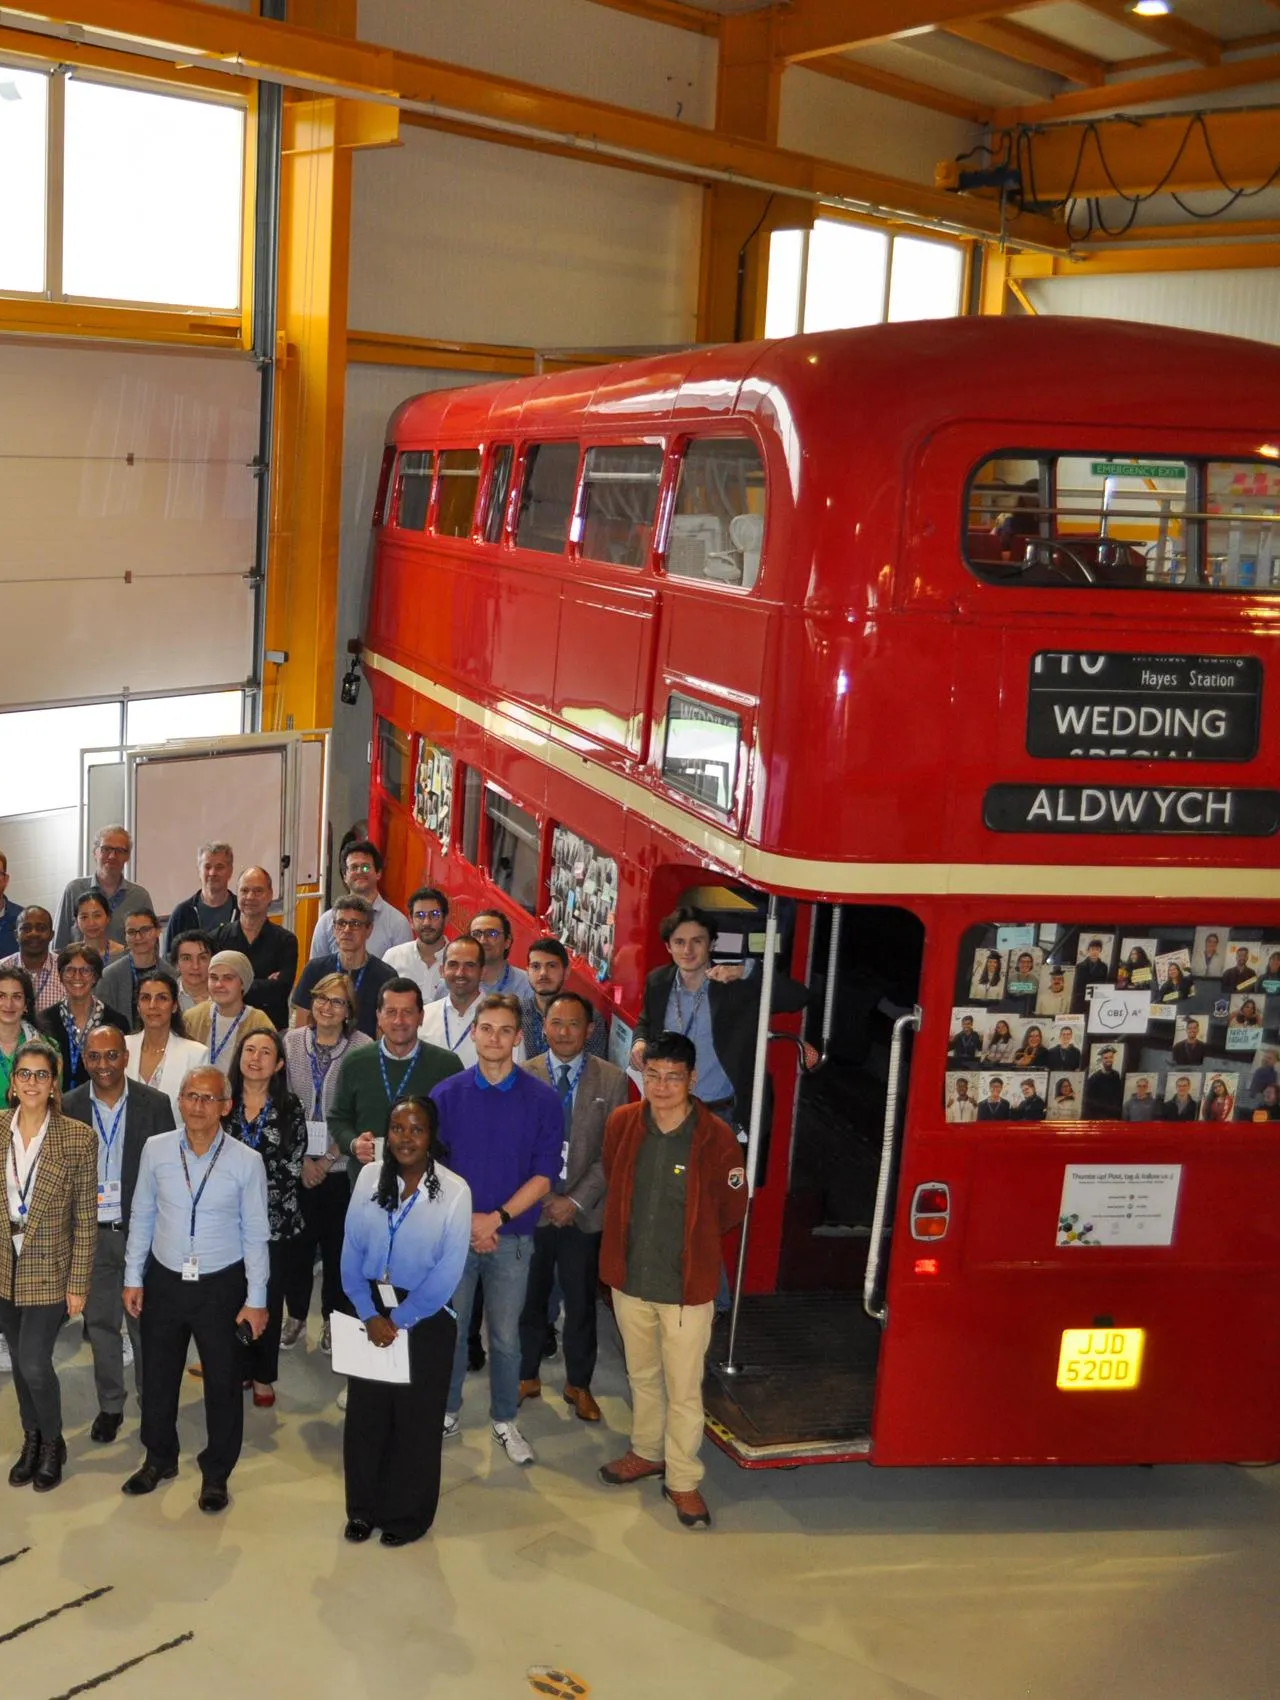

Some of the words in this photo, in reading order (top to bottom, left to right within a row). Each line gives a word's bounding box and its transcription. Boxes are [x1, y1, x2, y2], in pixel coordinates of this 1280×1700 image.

[1096, 464, 1156, 476] EMERGENCY
[1159, 467, 1179, 477] EXIT
[1141, 669, 1177, 690] Hayes
[1189, 670, 1235, 687] Station
[1054, 704, 1227, 738] WEDDING
[1026, 788, 1232, 823] ALDWYCH
[1078, 1333, 1125, 1355] JJD
